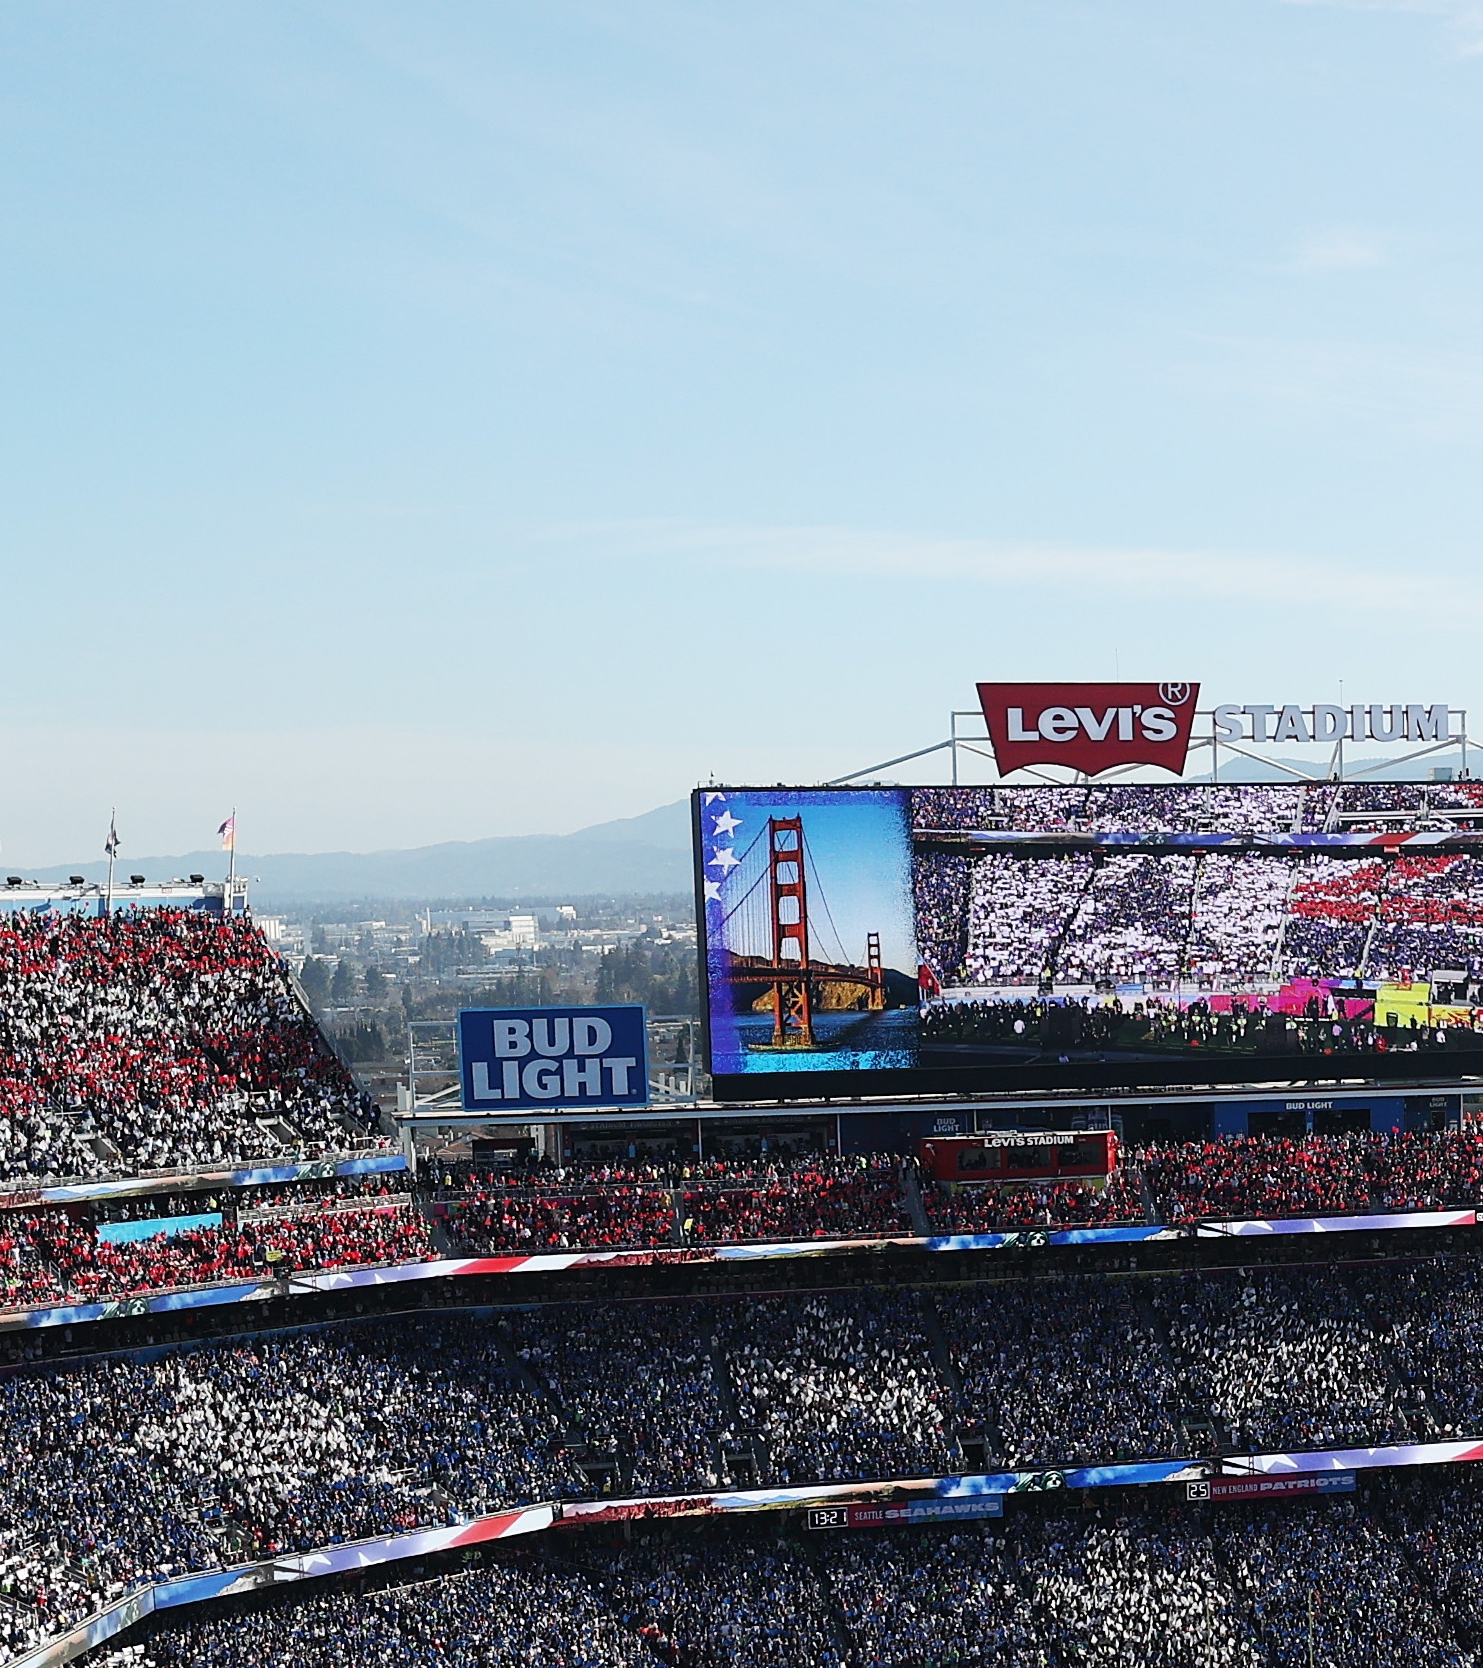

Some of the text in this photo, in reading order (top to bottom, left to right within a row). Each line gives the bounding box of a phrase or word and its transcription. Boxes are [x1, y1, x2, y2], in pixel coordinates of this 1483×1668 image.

[1214, 704, 1449, 743] STADIUM
[492, 1016, 613, 1058] BUD
[471, 1057, 637, 1101] LIGHT
[1286, 1101, 1333, 1110] BUD LIGHT
[933, 1124, 960, 1132] LIGHT
[1027, 1136, 1073, 1146] STADIUM
[1190, 1484, 1207, 1498] 25
[1212, 1475, 1355, 1496] NEW ENGLAND PATRIOTS
[814, 1510, 846, 1527] 13:21
[855, 1501, 999, 1521] SEATTLE SEAHAWKS
